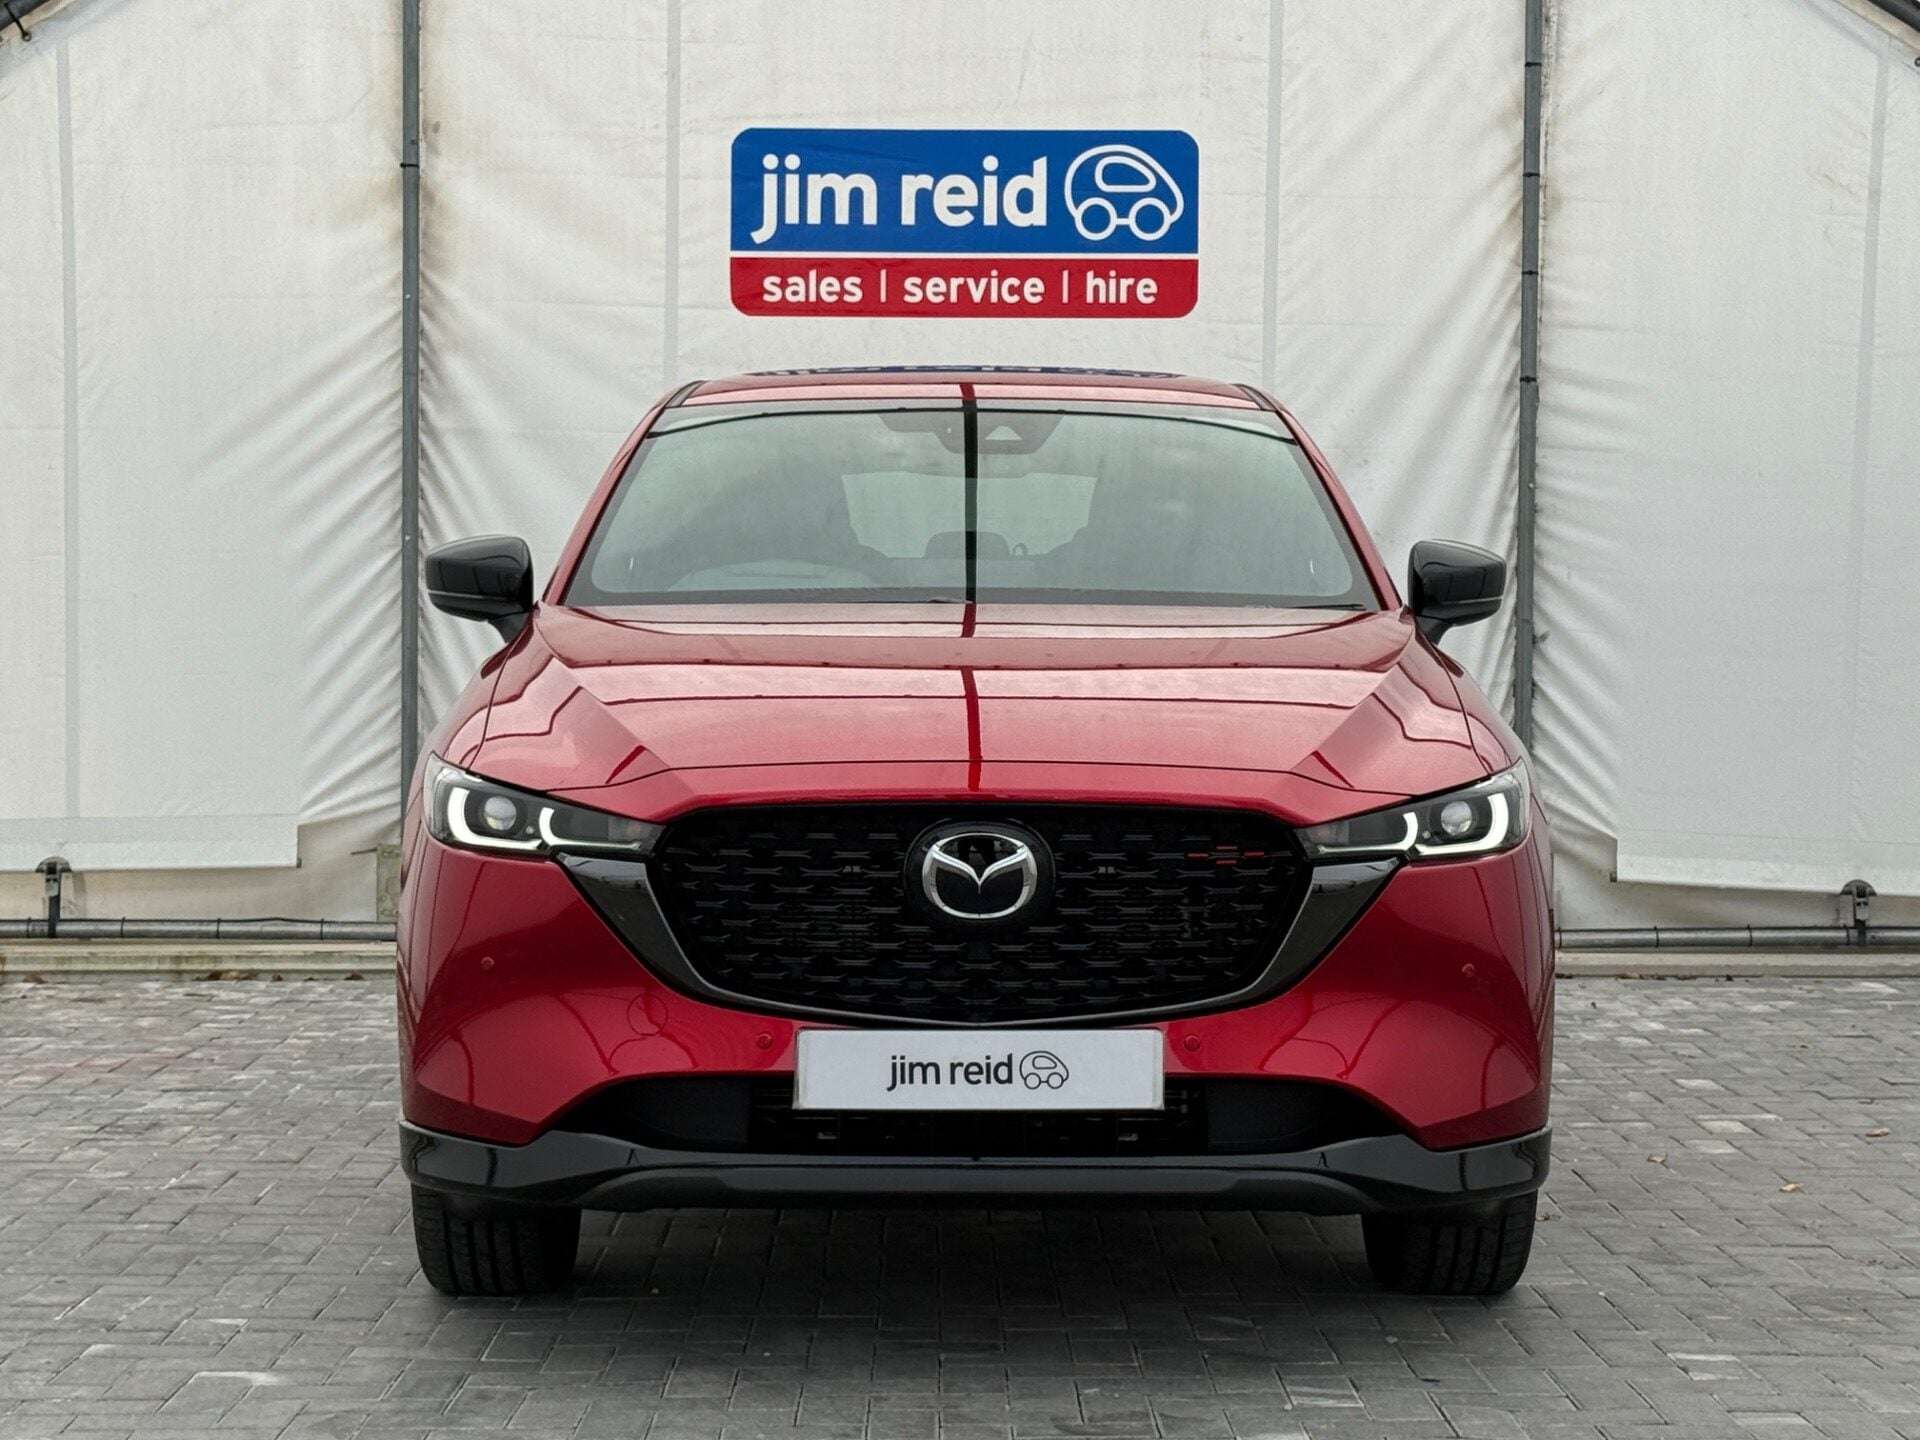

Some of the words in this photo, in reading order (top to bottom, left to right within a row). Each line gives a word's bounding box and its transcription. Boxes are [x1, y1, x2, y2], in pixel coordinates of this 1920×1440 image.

[750, 153, 878, 245] jim
[900, 155, 1048, 228] reid
[762, 269, 863, 304] sales
[903, 269, 1045, 304] service
[1086, 269, 1158, 304] hire
[886, 1054, 941, 1093] jim
[949, 1052, 1014, 1086] reid
